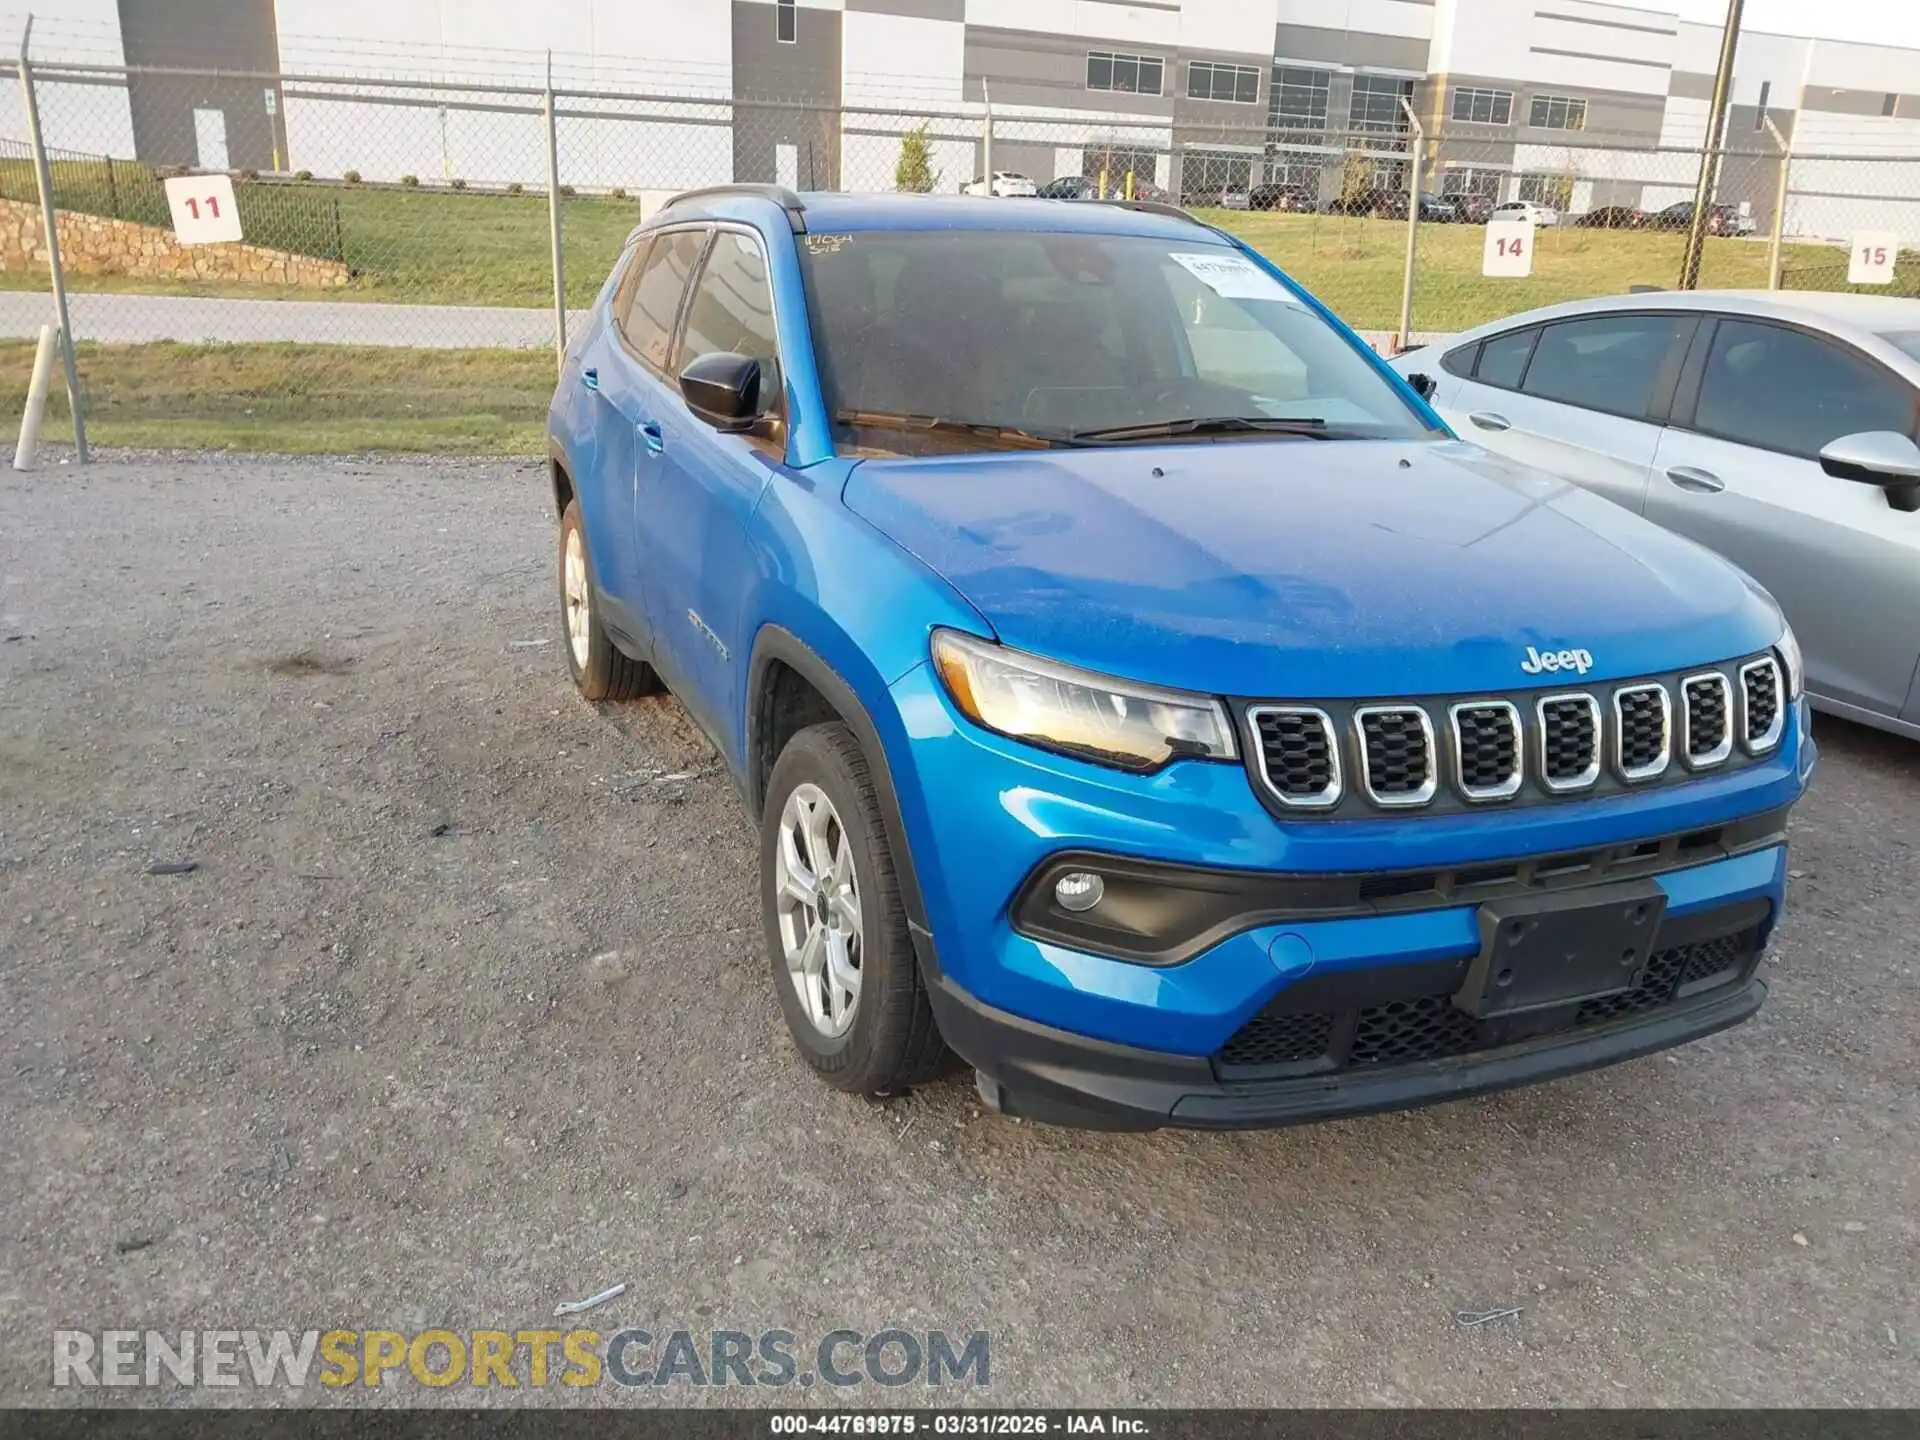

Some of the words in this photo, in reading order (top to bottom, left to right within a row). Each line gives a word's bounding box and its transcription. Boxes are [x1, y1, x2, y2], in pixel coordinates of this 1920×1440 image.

[184, 196, 220, 219] 11
[1496, 238, 1522, 257] 14
[1862, 247, 1887, 265] 15
[1521, 646, 1593, 675] Jeep
